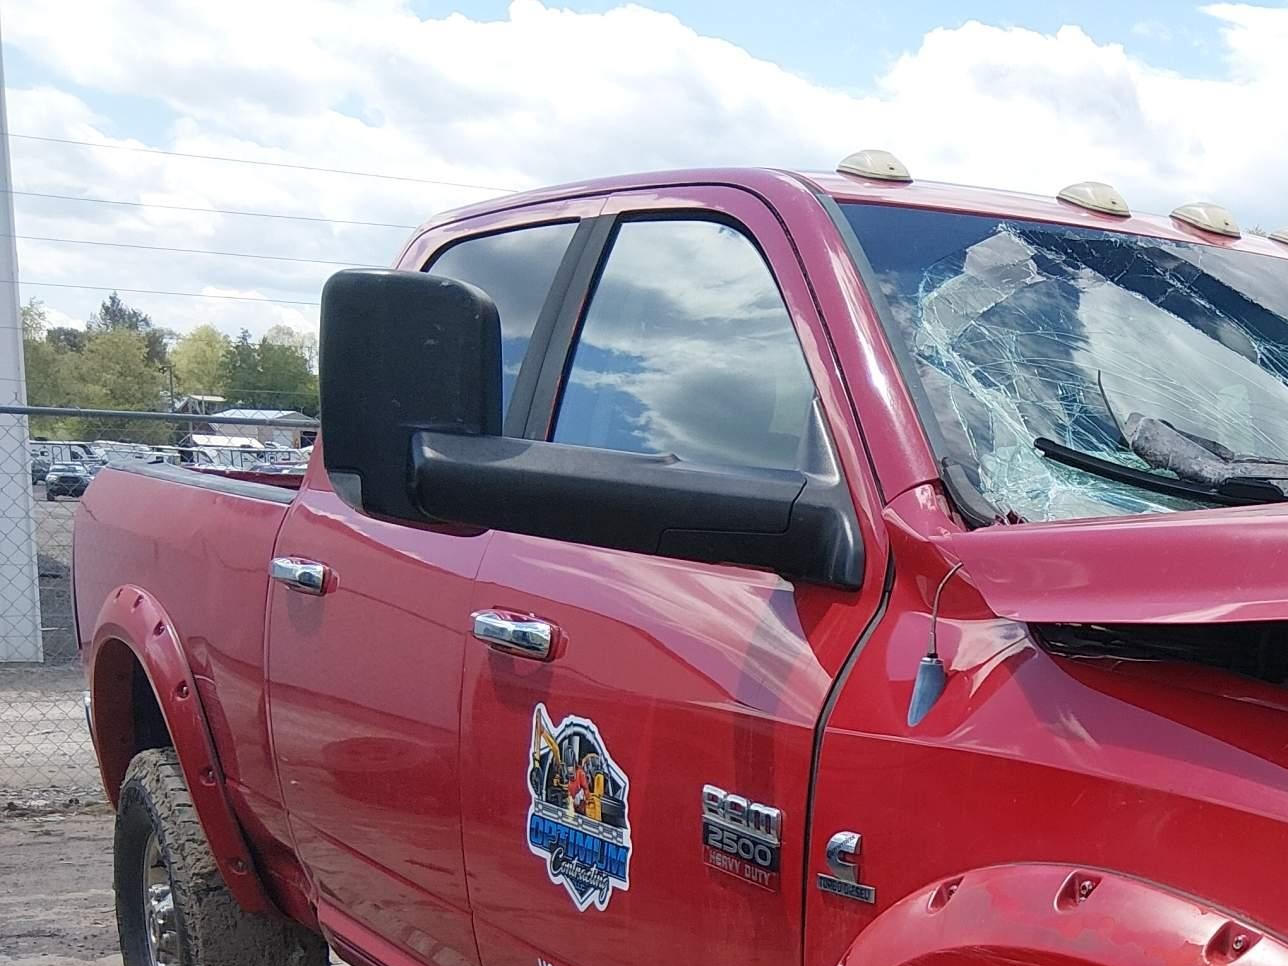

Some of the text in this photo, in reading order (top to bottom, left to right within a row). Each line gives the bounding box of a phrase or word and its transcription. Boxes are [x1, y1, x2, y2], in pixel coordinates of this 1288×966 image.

[702, 784, 782, 838] RAM
[530, 814, 630, 882] OPTIMUM
[707, 824, 773, 867] 2500
[708, 849, 771, 886] HEAVY DUTY
[550, 847, 610, 903] Contracting
